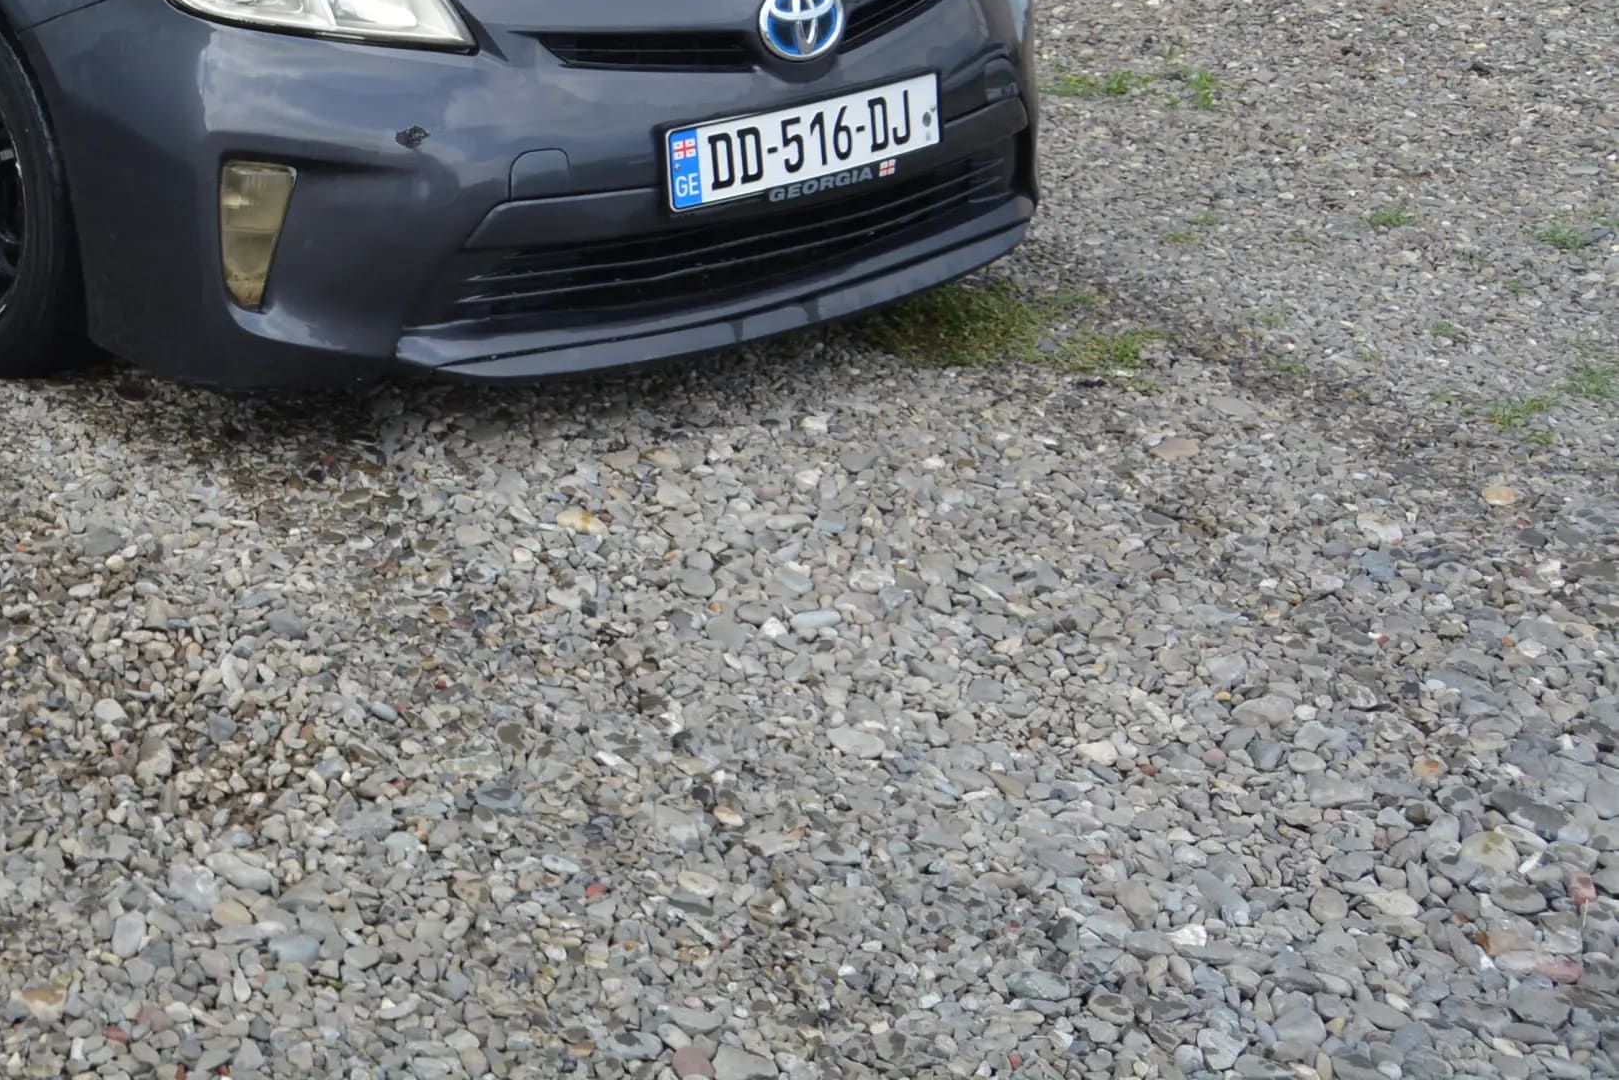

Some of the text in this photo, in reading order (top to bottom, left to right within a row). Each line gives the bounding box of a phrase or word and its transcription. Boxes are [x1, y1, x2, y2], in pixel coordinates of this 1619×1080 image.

[707, 90, 911, 191] DD-516-DJ
[675, 172, 700, 199] GE
[769, 167, 873, 202] GEORGIA
